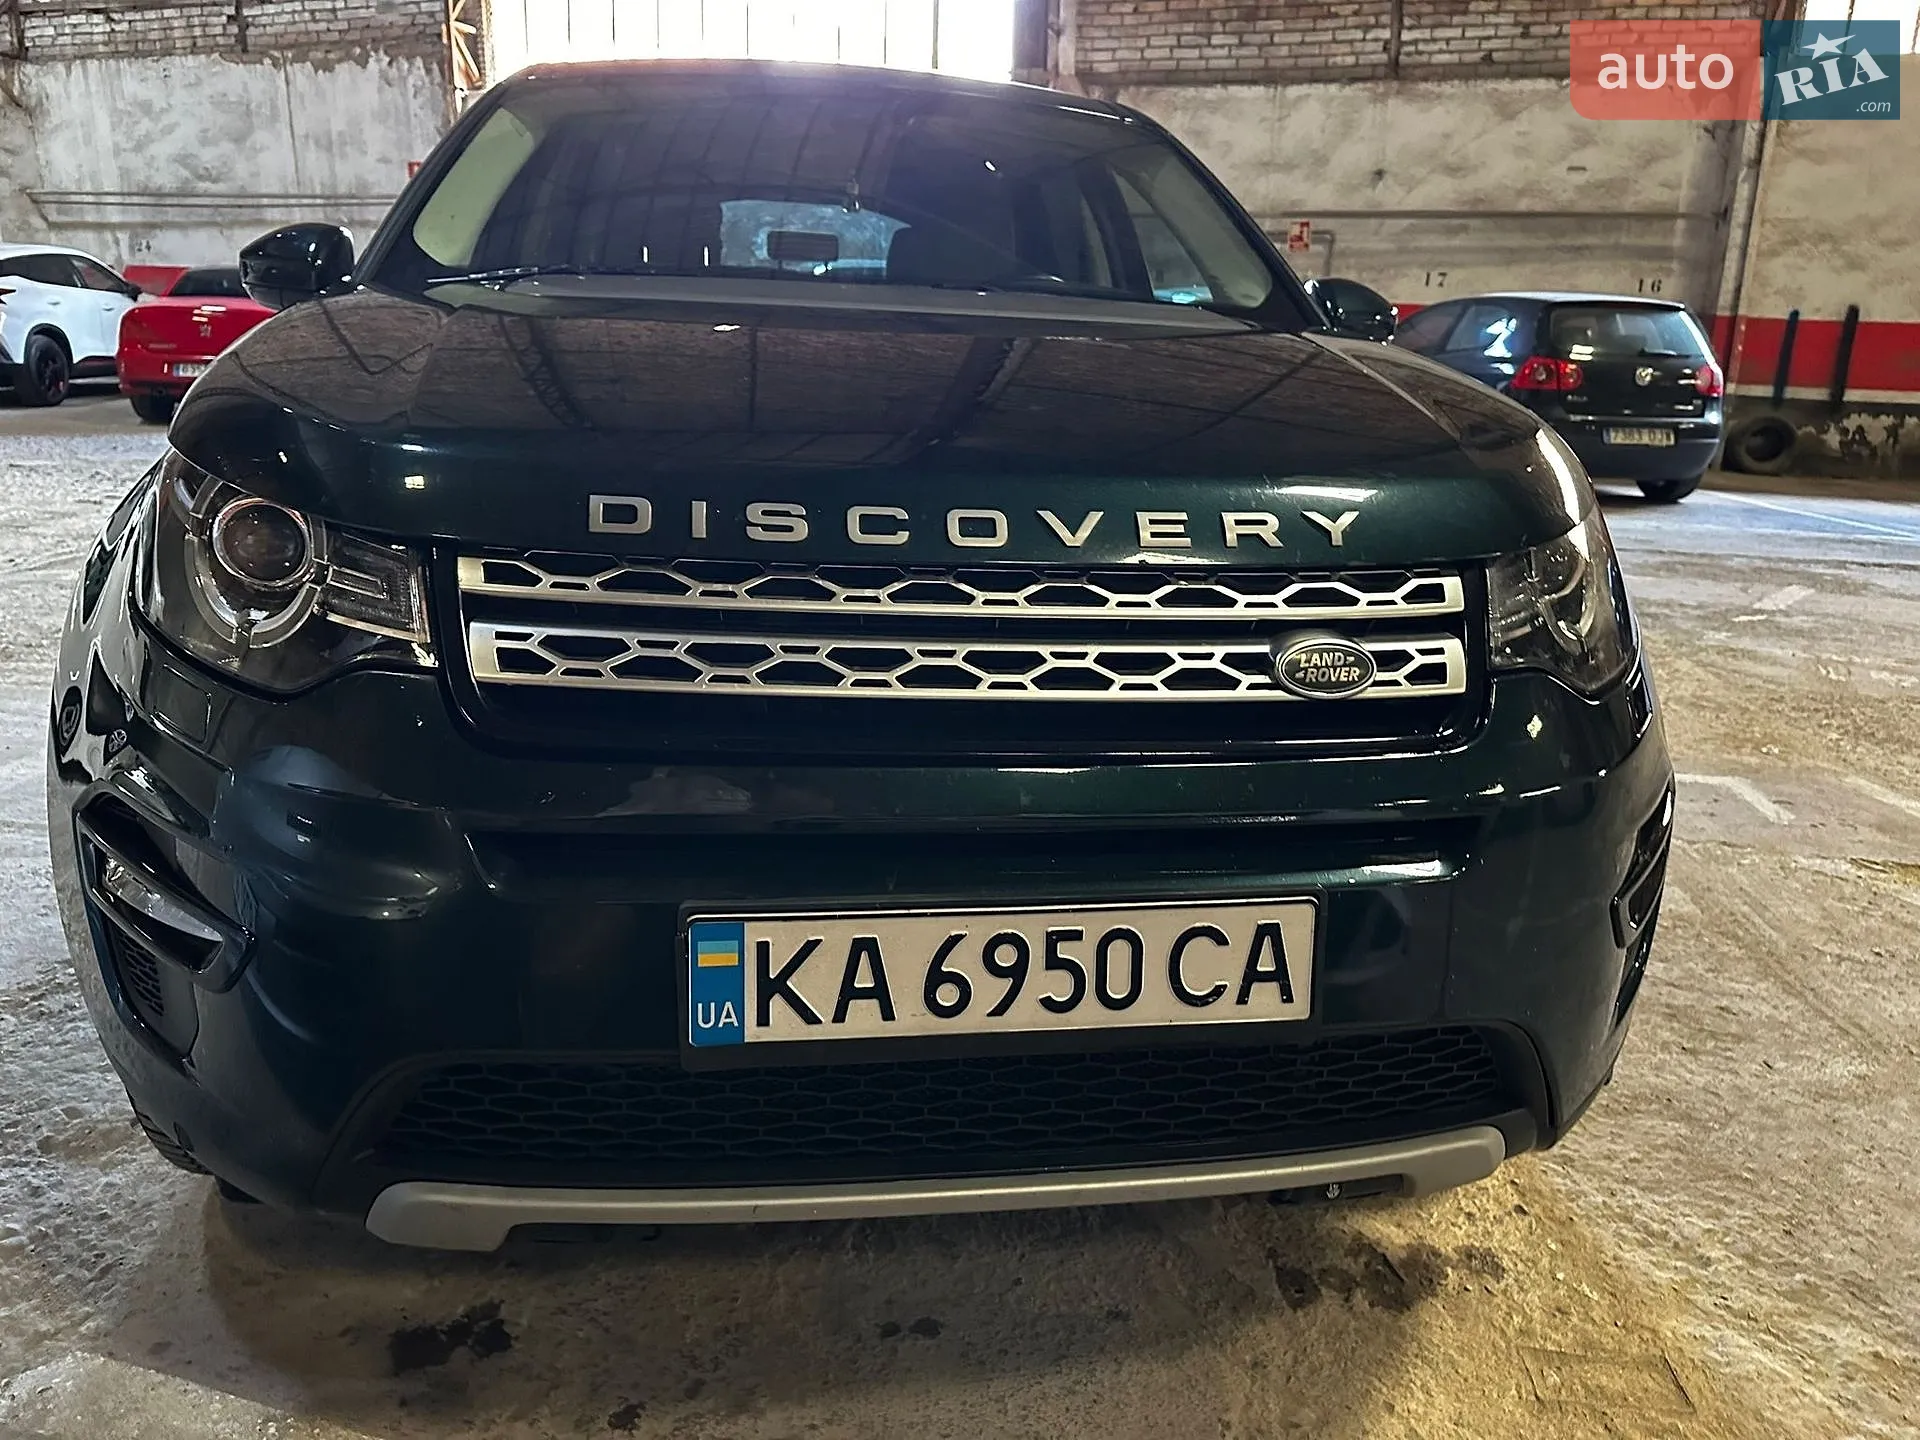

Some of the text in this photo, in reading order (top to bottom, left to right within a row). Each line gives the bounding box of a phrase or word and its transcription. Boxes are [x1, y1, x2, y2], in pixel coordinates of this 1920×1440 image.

[1424, 271, 1448, 288] 17
[1637, 277, 1663, 294] 16
[588, 494, 1360, 549] DISCOVERY
[1305, 666, 1361, 683] ROVER
[755, 920, 1295, 1028] KA 6950 CA
[697, 1001, 739, 1029] UA
